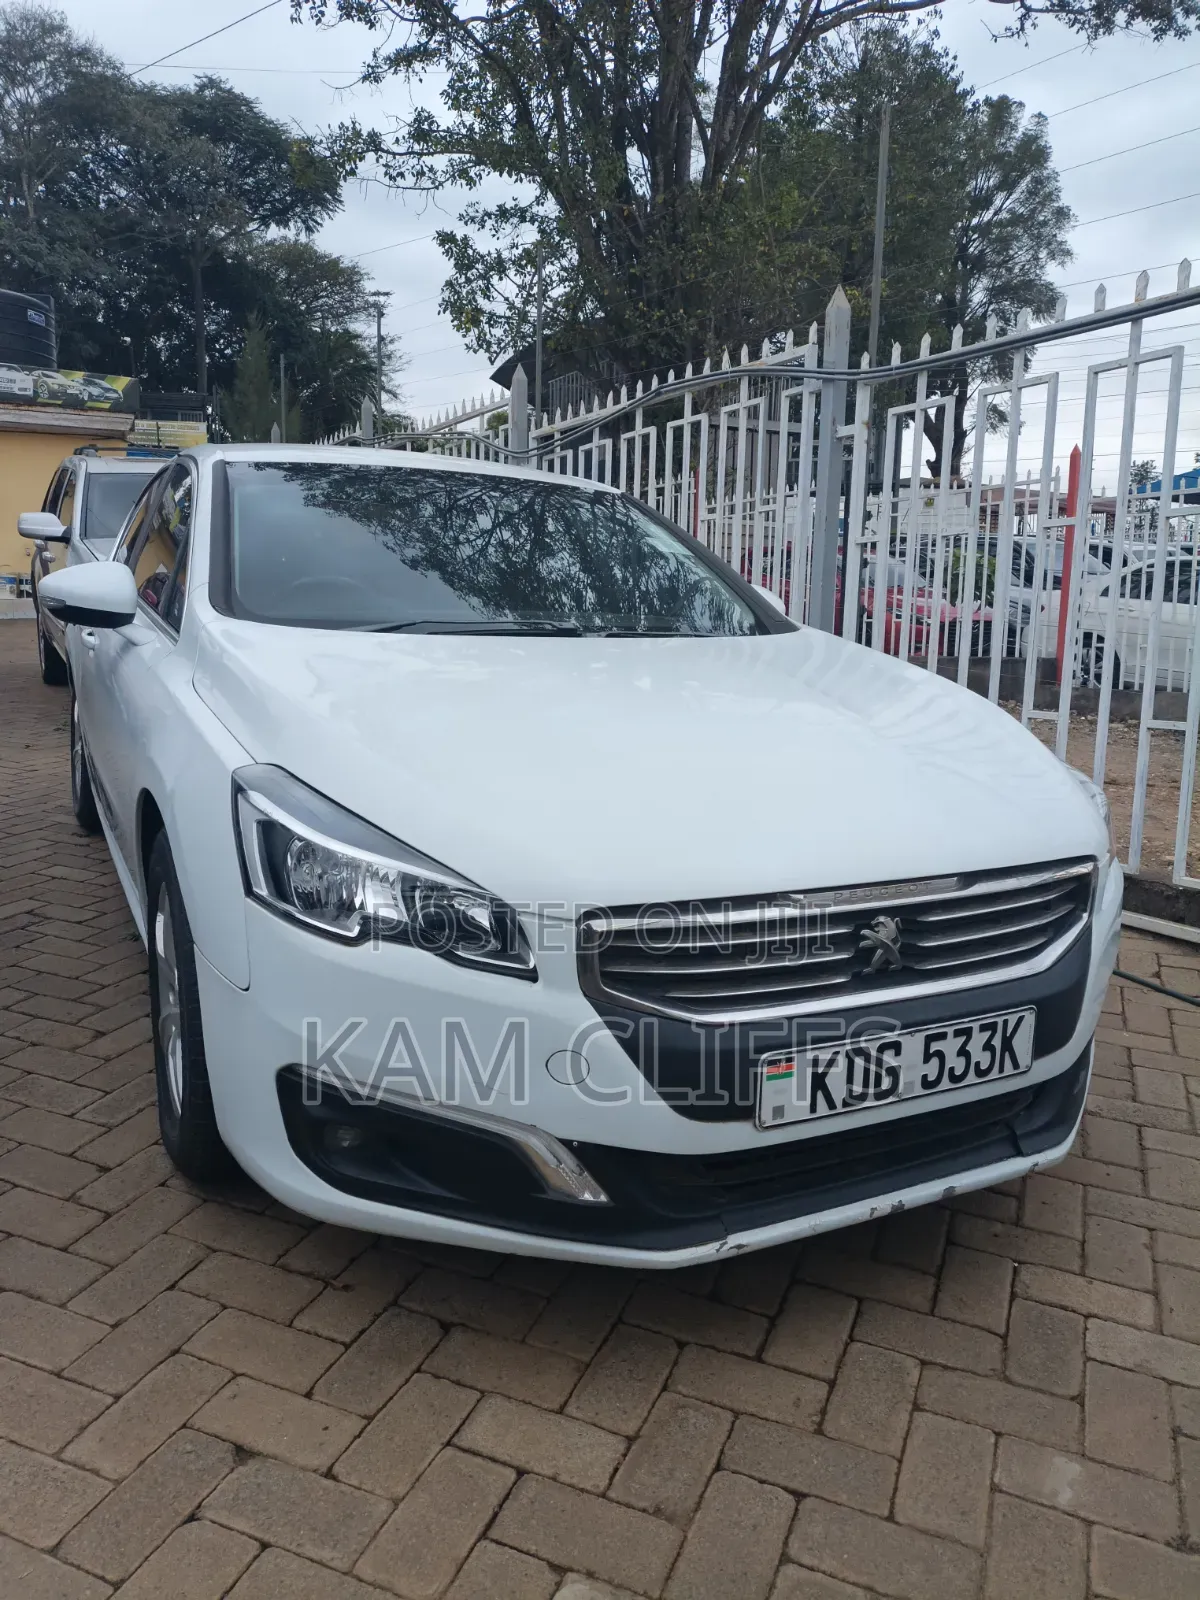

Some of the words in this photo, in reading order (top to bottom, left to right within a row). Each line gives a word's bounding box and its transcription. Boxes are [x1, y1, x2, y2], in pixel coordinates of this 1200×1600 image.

[834, 882, 932, 900] PEUGEOT
[809, 1040, 903, 1114] KDG
[920, 1014, 1026, 1090] 533K
